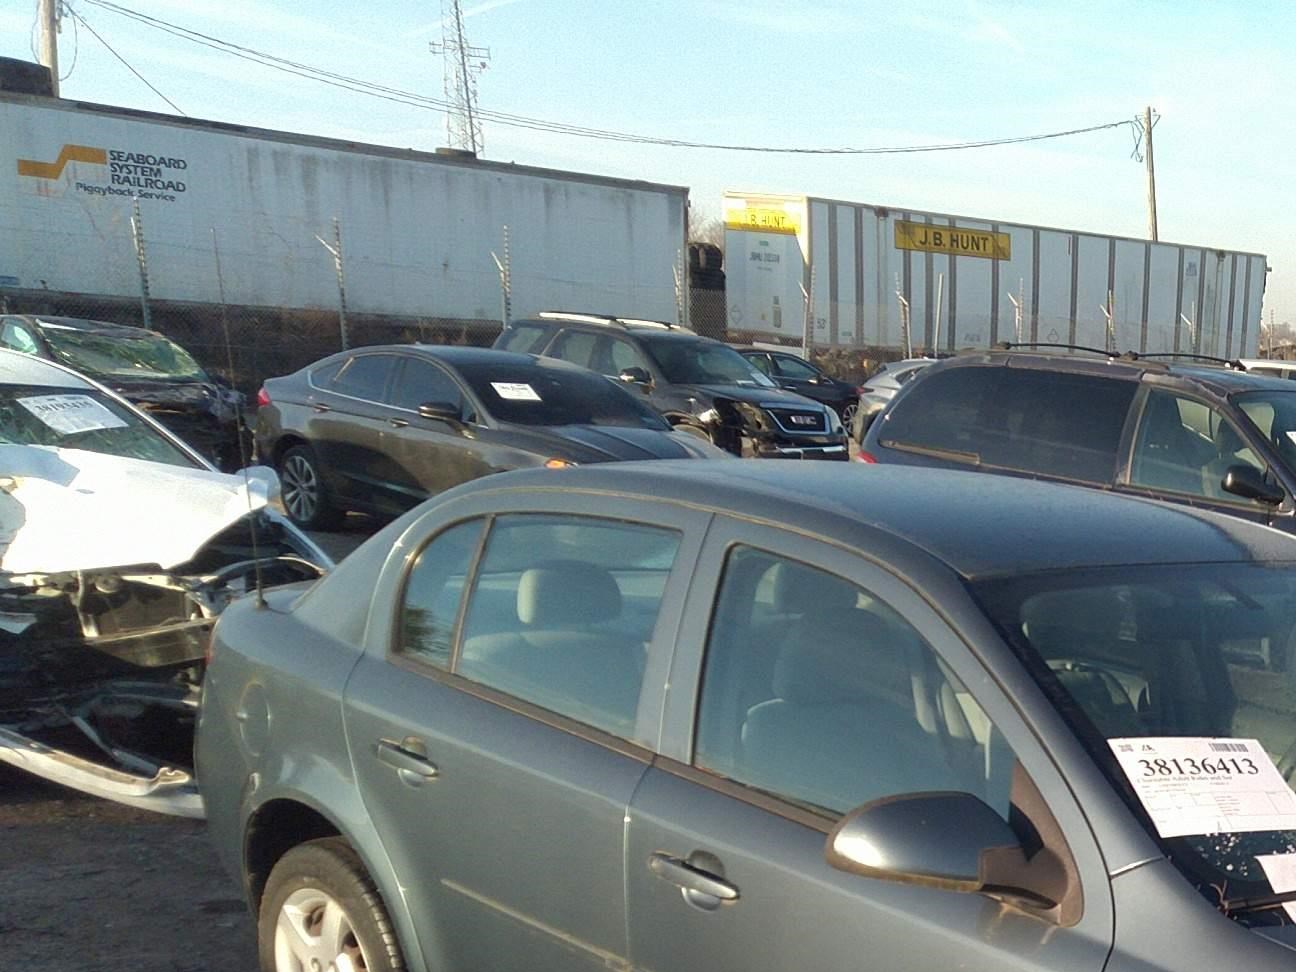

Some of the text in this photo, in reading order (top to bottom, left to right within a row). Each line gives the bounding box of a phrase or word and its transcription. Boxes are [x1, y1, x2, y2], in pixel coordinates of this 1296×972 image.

[109, 150, 187, 170] SEABOARD
[109, 162, 163, 178] SYSTEM
[75, 182, 176, 201] Piggyback Service
[111, 174, 186, 192] RAILROAD
[919, 229, 988, 252] J.B. HUNT
[1137, 757, 1259, 776] 38136413
